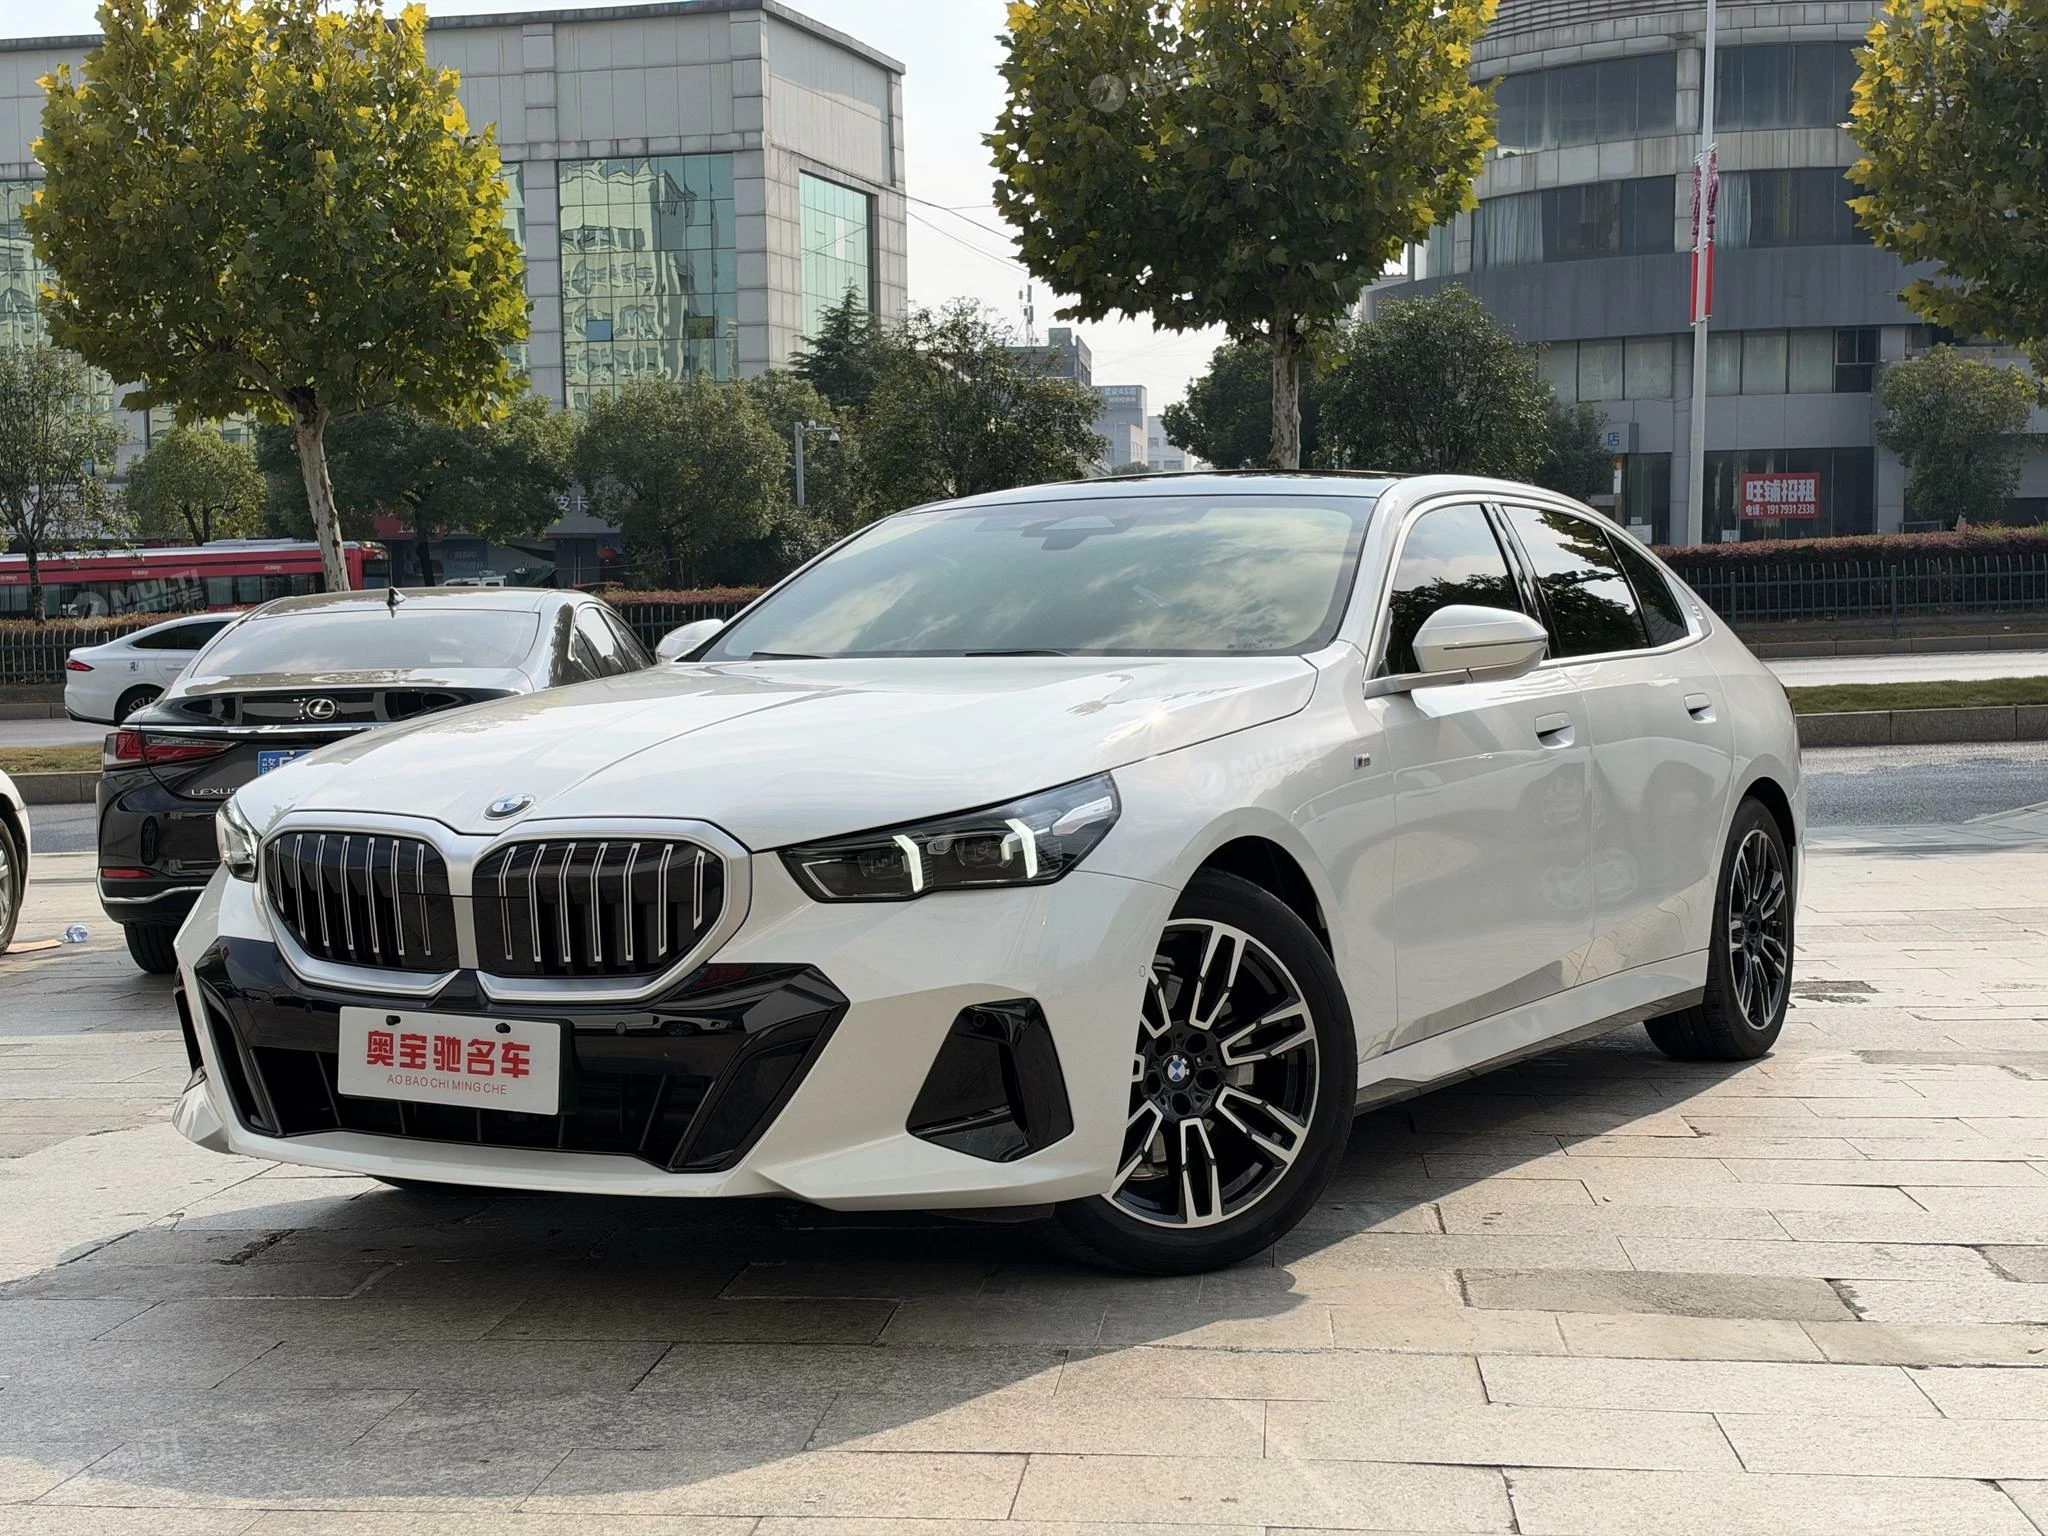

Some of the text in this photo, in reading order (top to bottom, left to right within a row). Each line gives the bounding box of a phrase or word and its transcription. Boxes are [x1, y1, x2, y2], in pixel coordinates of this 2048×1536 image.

[1746, 479, 1816, 502] 旺铺招租
[367, 1030, 530, 1078] 奥宝驰名车
[387, 1074, 507, 1095] AO BAO CHI MING CHE
